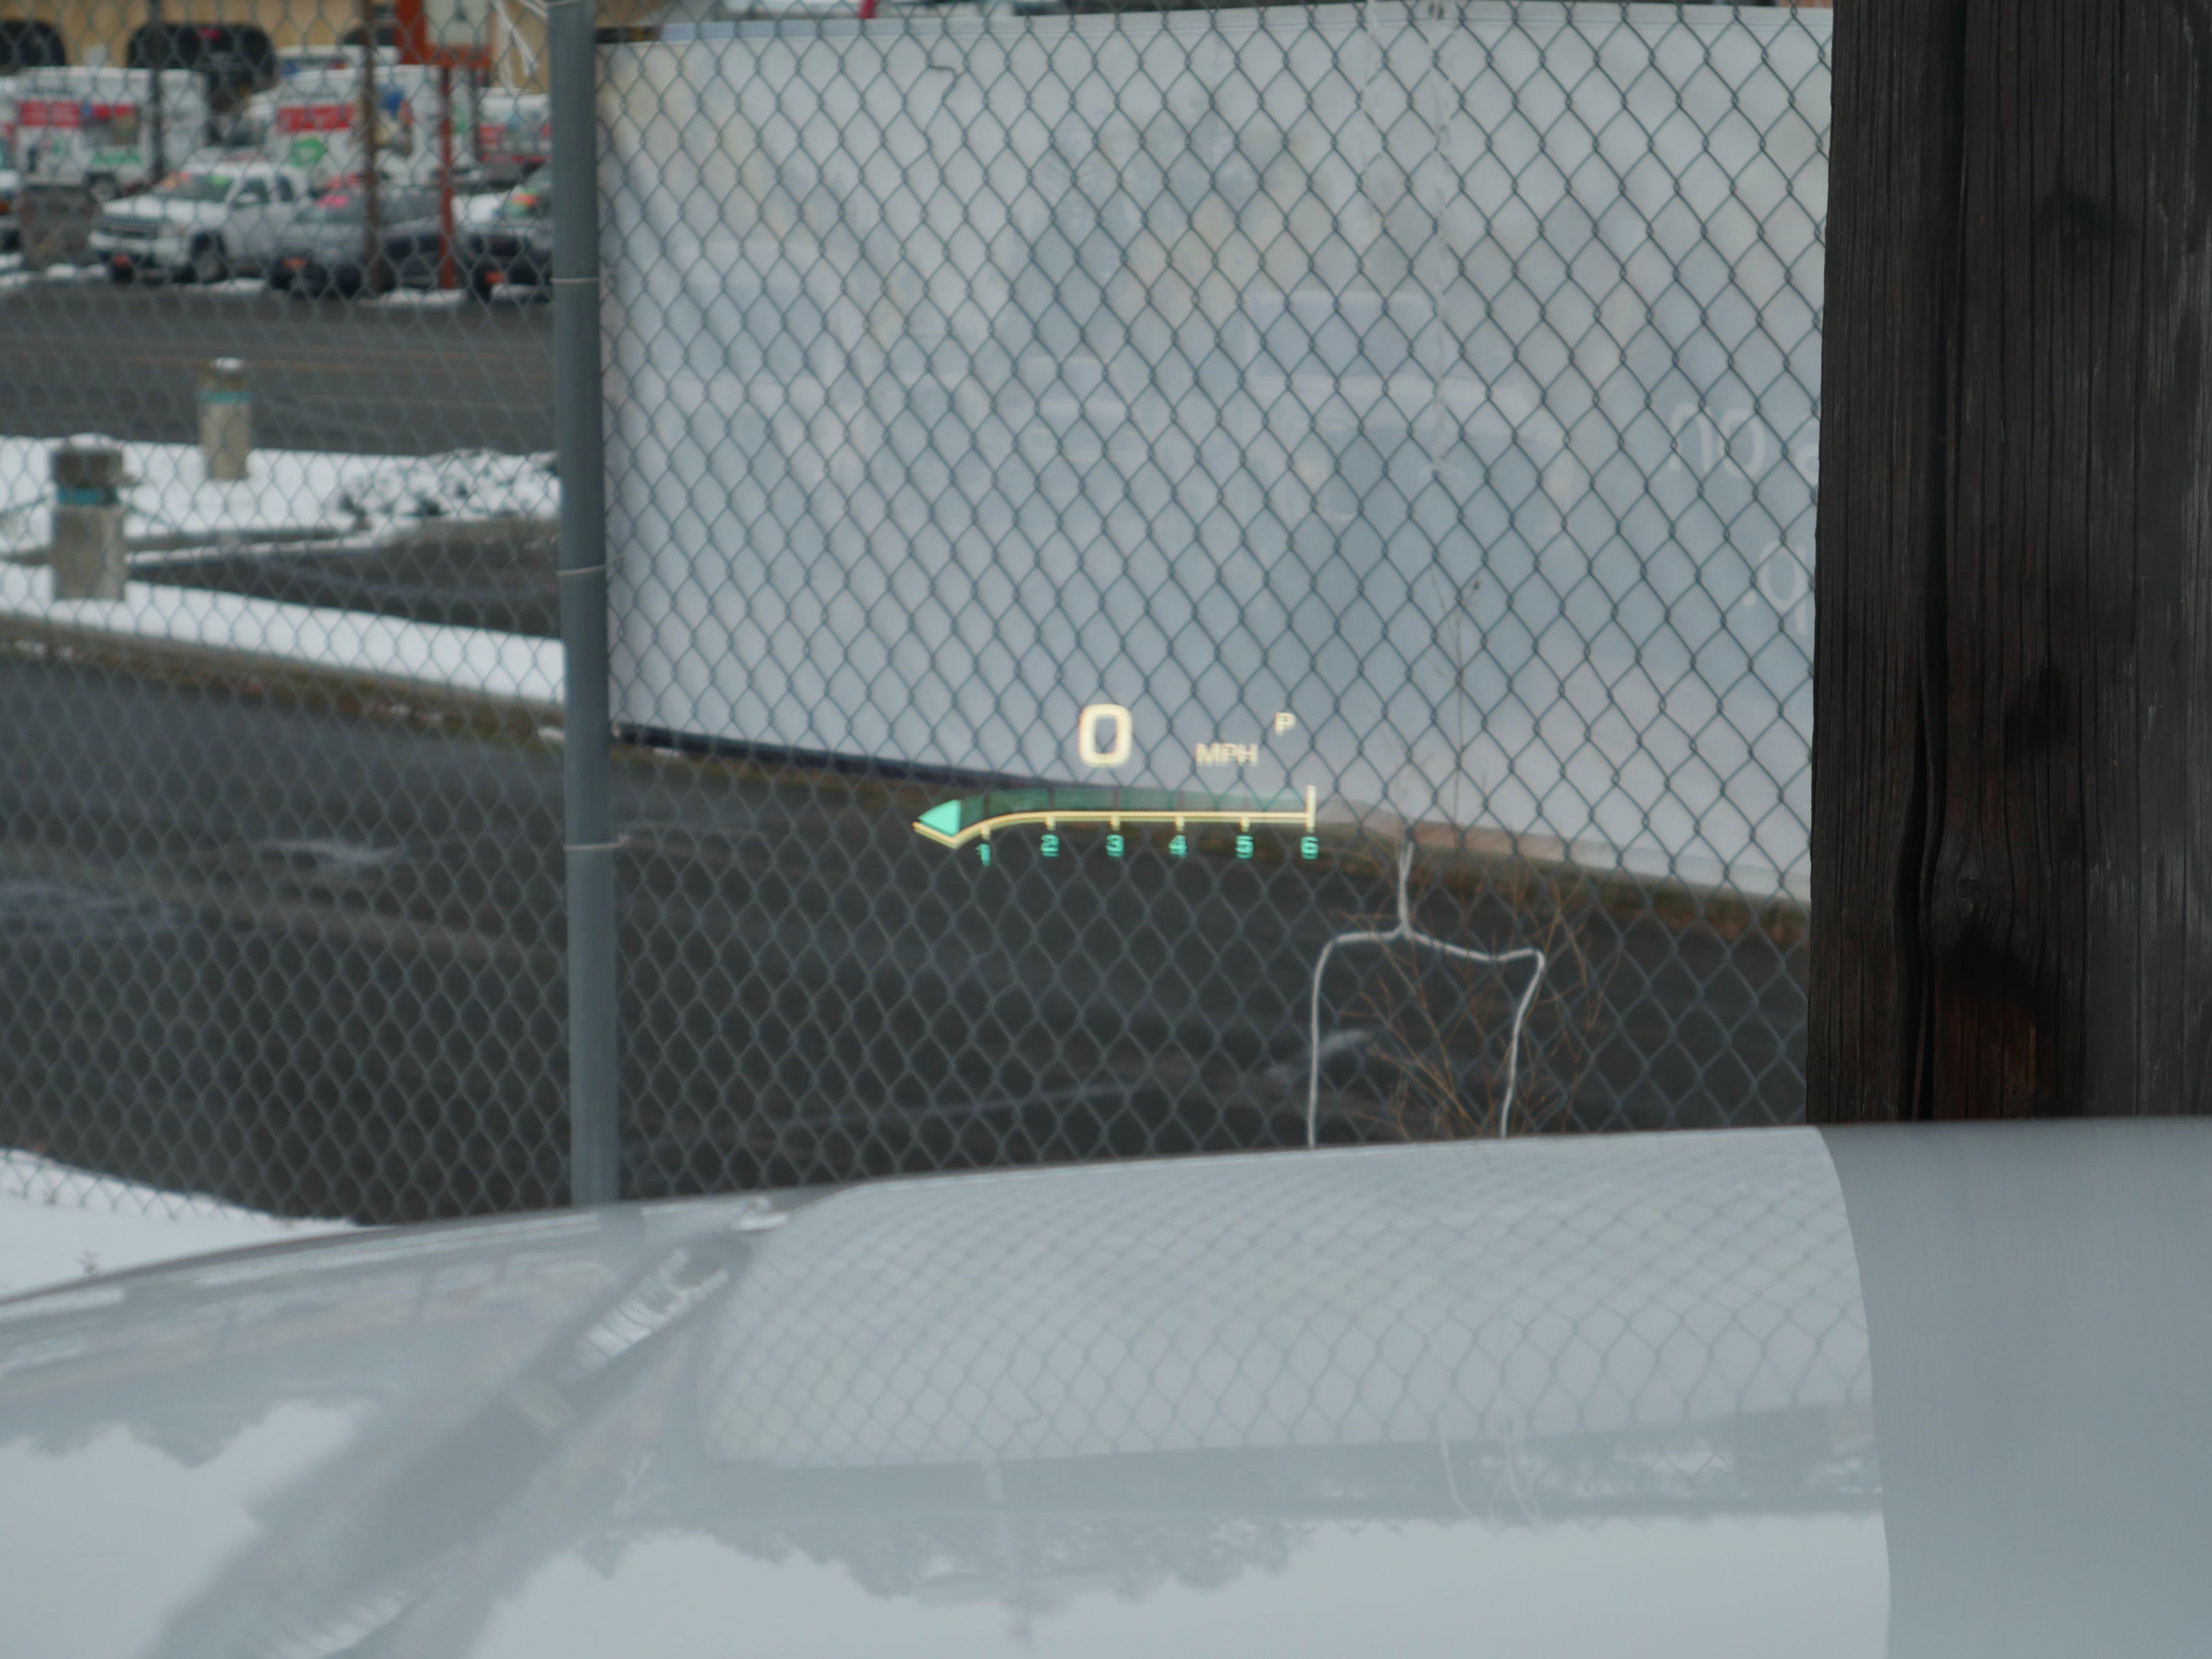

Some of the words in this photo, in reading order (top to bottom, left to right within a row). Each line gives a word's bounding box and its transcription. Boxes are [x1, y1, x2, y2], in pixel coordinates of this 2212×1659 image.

[1079, 704, 1132, 766] 0
[1196, 743, 1259, 764] MPH
[1274, 712, 1296, 735] P
[977, 844, 991, 865] 1
[1041, 835, 1059, 857] 2
[1106, 835, 1124, 857] 3
[1169, 834, 1187, 857] 4
[1235, 836, 1254, 858] 5
[1301, 836, 1319, 859] 6
